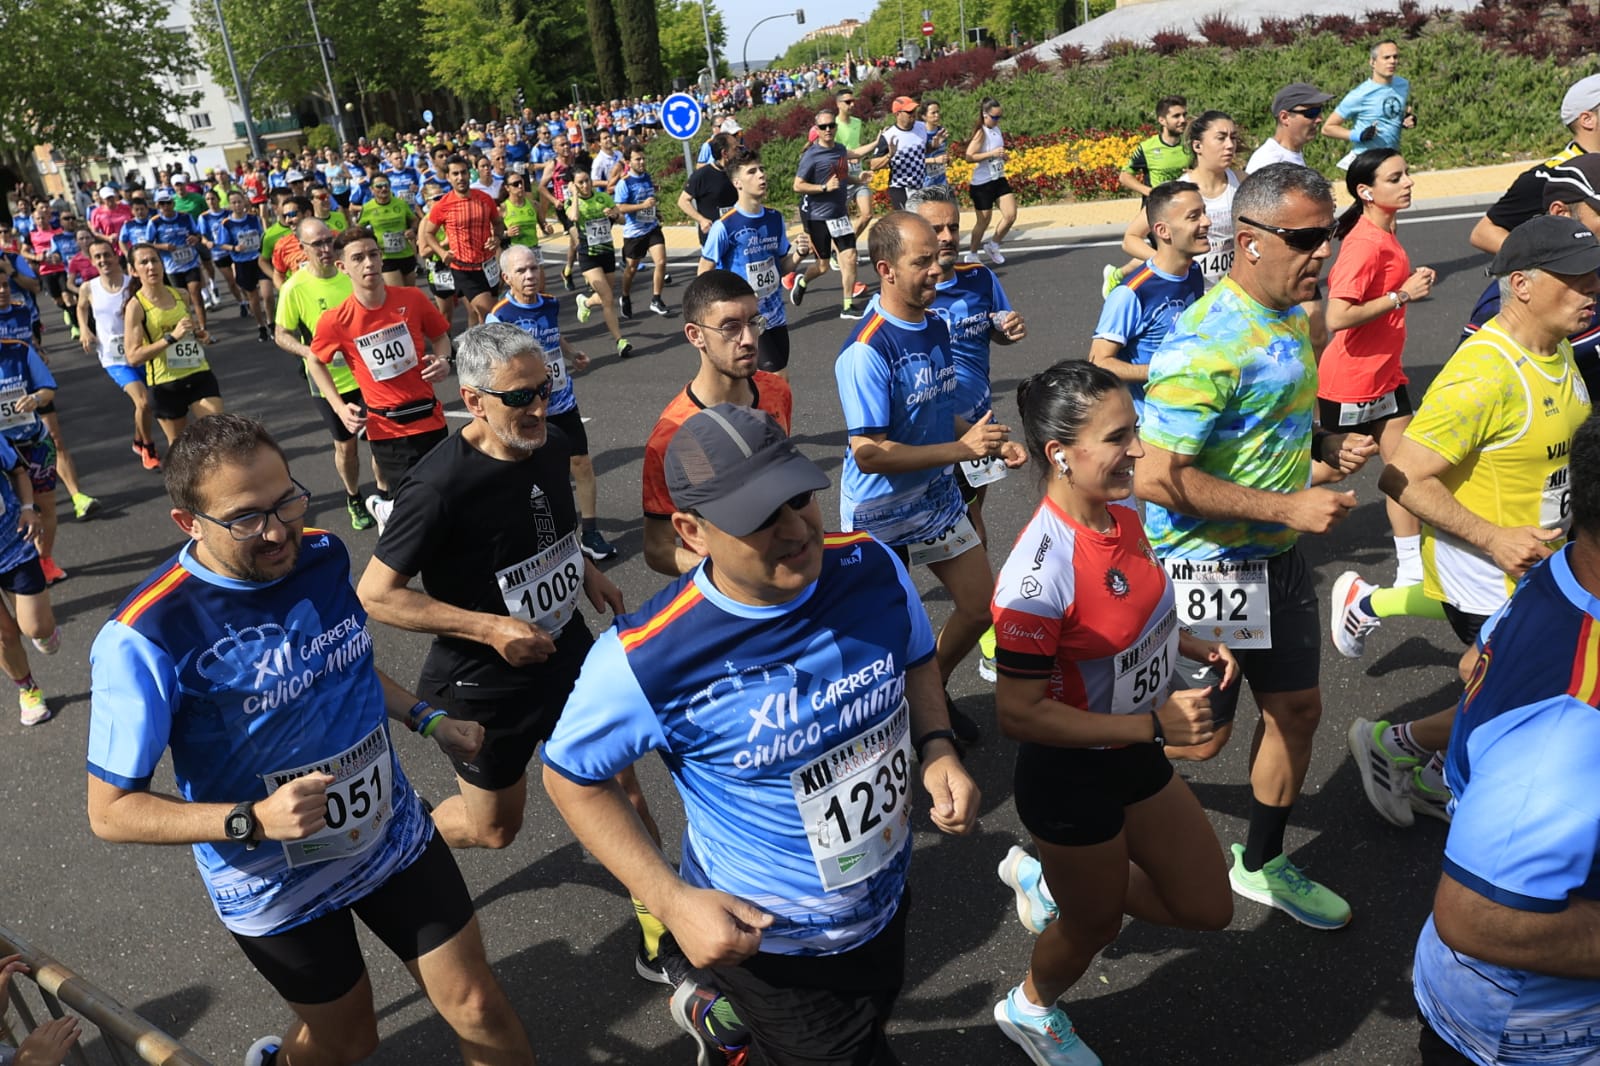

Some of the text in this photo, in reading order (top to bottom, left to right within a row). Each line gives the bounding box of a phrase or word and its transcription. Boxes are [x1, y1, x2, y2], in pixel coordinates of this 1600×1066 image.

[756, 270, 775, 287] 849
[1200, 251, 1235, 275] 1408
[175, 343, 200, 357] 654
[372, 340, 406, 366] 940
[914, 365, 933, 390] XII
[1032, 533, 1052, 571] VERGE
[503, 566, 527, 589] XII
[520, 562, 580, 619] 1008
[1187, 588, 1248, 621] 812
[301, 614, 361, 662] CARRERA
[252, 641, 293, 691] XII
[810, 651, 895, 712] CARRERA
[1132, 644, 1169, 704] 581
[746, 686, 799, 744] XII
[831, 745, 855, 766] SAN
[799, 758, 833, 796] XII
[824, 748, 908, 844] 1239
